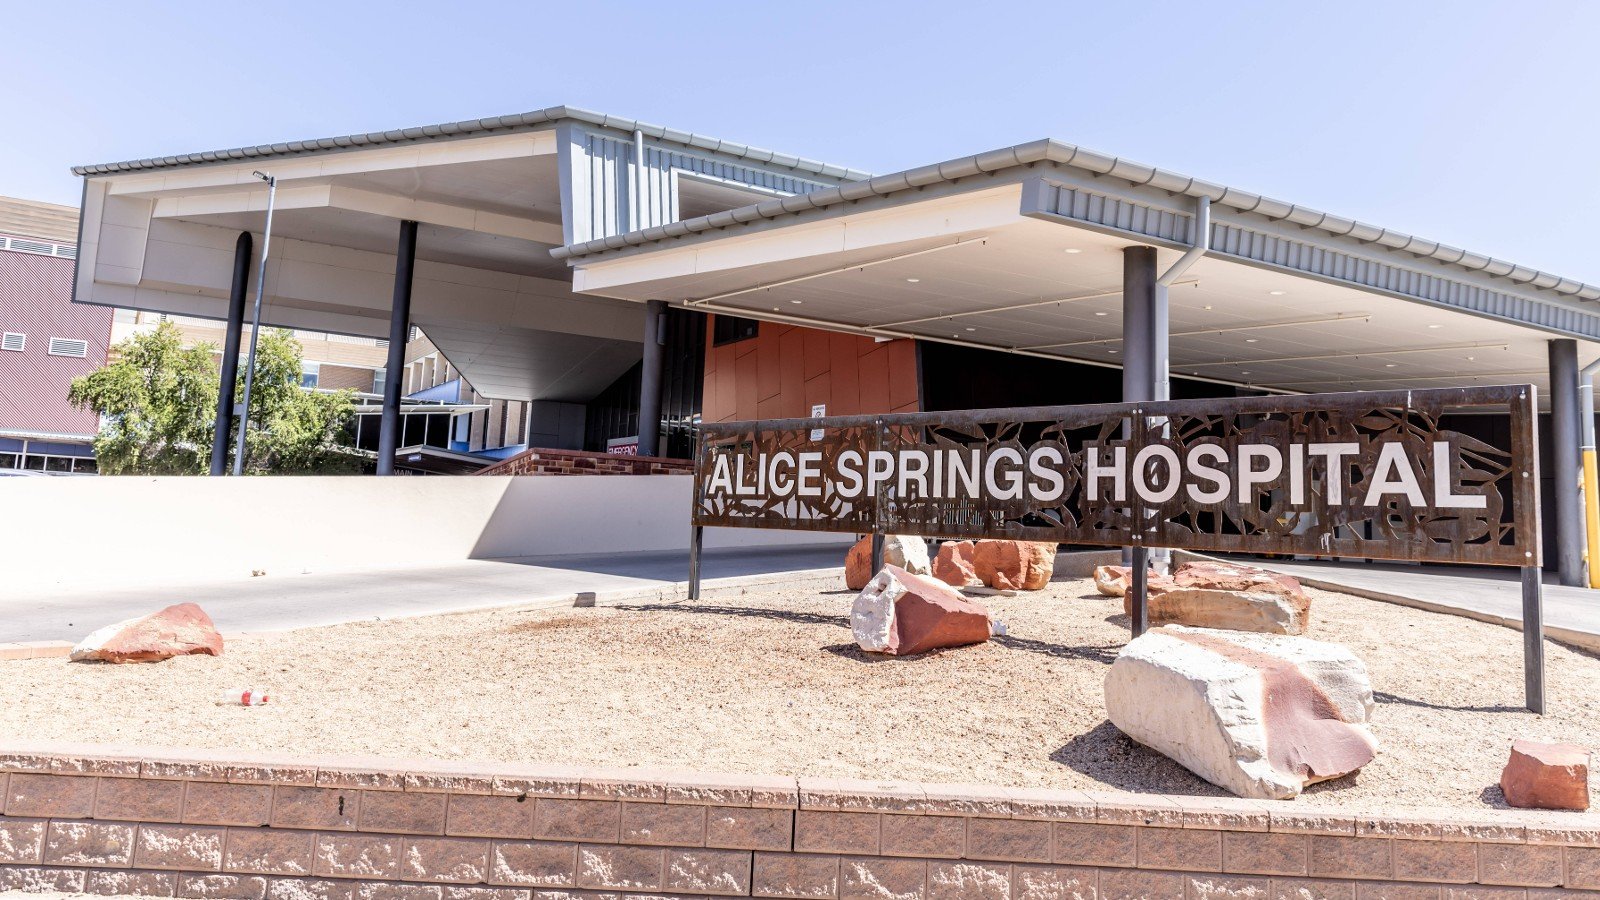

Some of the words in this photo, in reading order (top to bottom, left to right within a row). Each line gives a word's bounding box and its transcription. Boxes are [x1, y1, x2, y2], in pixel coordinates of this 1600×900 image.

[608, 445, 638, 456] EMERGENCY
[708, 451, 822, 497] ALICE
[836, 446, 1066, 502] SPRINGS
[1086, 441, 1487, 509] HOSPITAL
